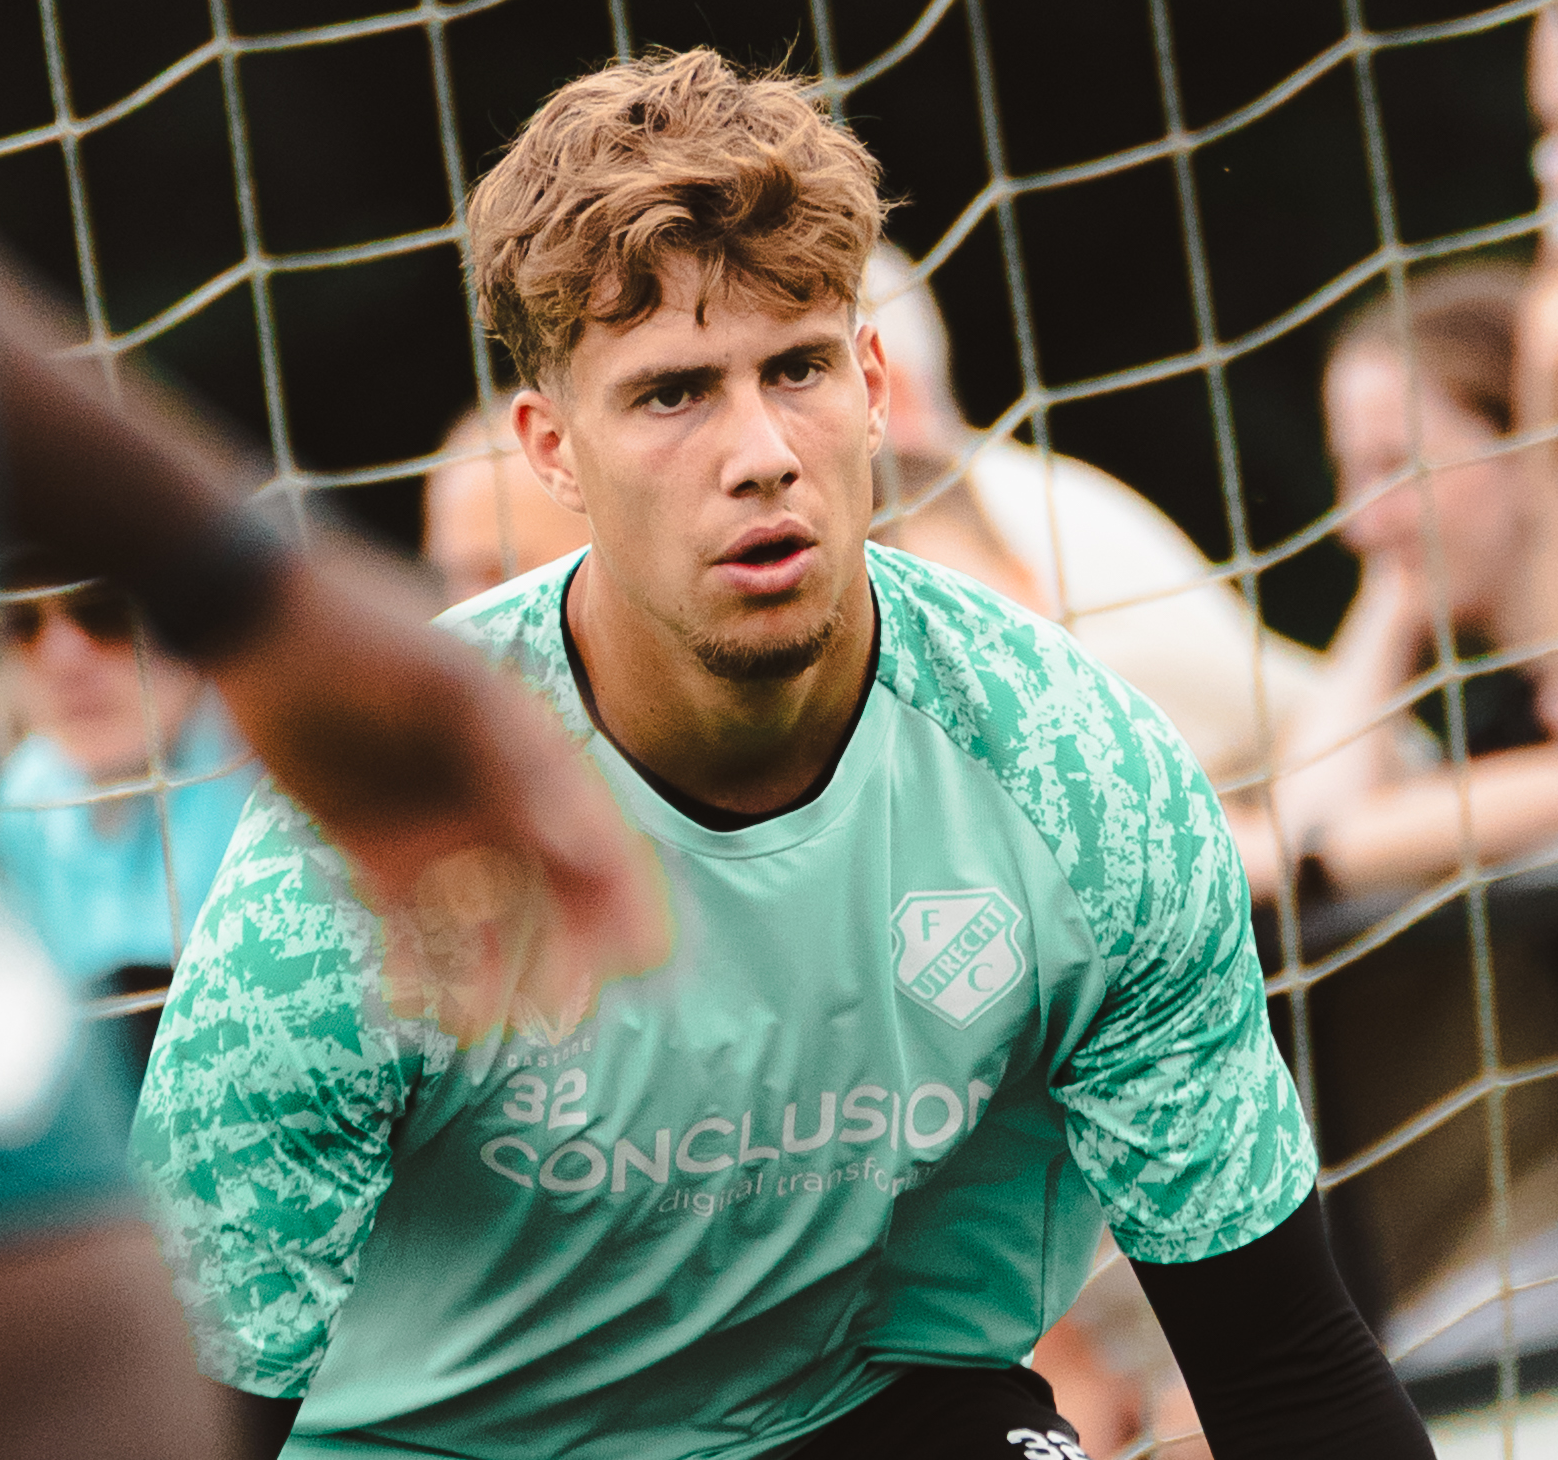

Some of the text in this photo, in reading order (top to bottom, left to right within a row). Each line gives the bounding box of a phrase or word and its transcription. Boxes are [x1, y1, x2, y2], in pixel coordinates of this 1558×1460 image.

[921, 908, 940, 942] F
[911, 901, 1007, 1000] UTRECHT
[967, 962, 994, 993] C
[506, 1037, 592, 1069] CASTORE
[502, 1067, 588, 1131] 32
